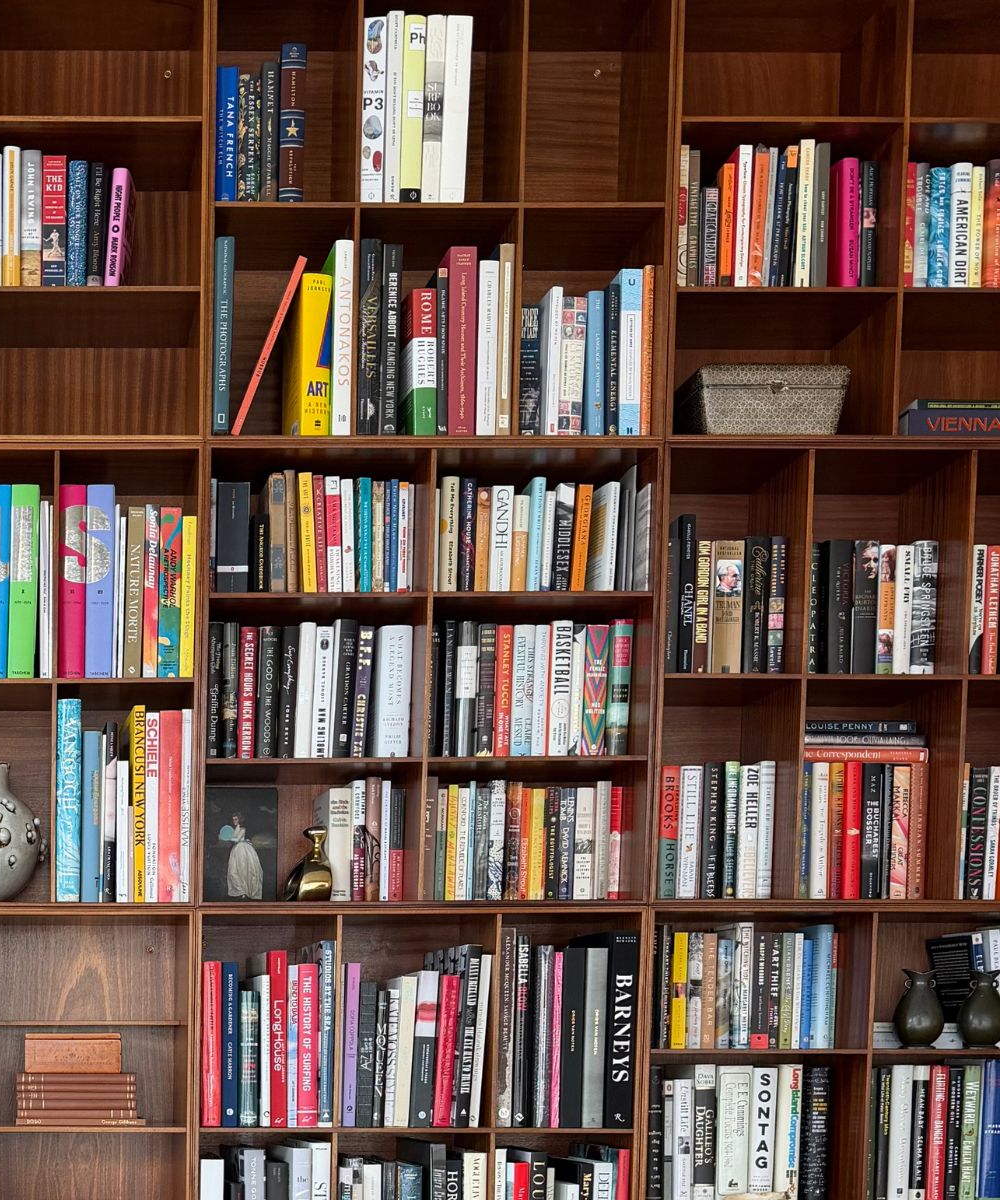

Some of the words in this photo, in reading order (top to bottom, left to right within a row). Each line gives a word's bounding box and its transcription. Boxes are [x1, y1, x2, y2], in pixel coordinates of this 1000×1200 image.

[226, 96, 235, 127] TANA
[363, 97, 383, 110] P3
[225, 133, 234, 178] FRENCH
[27, 162, 35, 187] JOHN
[46, 175, 63, 183] THE
[46, 184, 63, 192] KID
[27, 190, 35, 225] IRVING
[114, 185, 123, 202] NIGHT
[112, 202, 122, 223] PEOPLE
[955, 199, 969, 256] AMERICAN
[110, 237, 119, 254] MARK
[108, 255, 117, 278] RONSON
[954, 260, 967, 285] DIRT
[388, 272, 397, 309] BERENICE
[387, 310, 396, 338] ABBOTT
[420, 291, 432, 335] ROME
[338, 276, 351, 387] ANTONAKOS
[366, 296, 378, 379] VERSAILLES
[386, 341, 395, 379] CHANGING
[417, 340, 426, 386] HUGHES
[425, 340, 435, 385] ROBERT
[306, 381, 328, 398] ART
[386, 381, 394, 397] NEW
[385, 400, 394, 419] YORK
[926, 416, 1000, 432] VIENNA
[148, 509, 159, 539] Sonia
[495, 488, 510, 549] GANDHI
[169, 548, 178, 573] ANDY
[556, 519, 572, 572] MIDDLESEX
[698, 540, 711, 556] KIM
[920, 547, 932, 579] BRUCE
[128, 544, 141, 597] NATURE
[145, 540, 157, 590] Delaunay
[697, 556, 710, 588] GORDON
[975, 549, 985, 578] PARKER
[989, 551, 999, 594] JONATHAN
[162, 555, 170, 609] RETROSPECTIVE
[168, 574, 178, 609] WARHOL
[696, 590, 709, 606] GIRL
[975, 579, 984, 605] POSEY
[127, 600, 140, 644] MORTE
[683, 583, 694, 626] CHANEL
[696, 607, 708, 615] IN
[920, 582, 931, 646] SPRINGSTEEN
[988, 597, 998, 629] LETHEM
[358, 631, 373, 670] B.F.F.
[695, 623, 708, 644] BAND
[244, 643, 255, 671] SECRET
[502, 634, 511, 676] STANLEY
[554, 626, 572, 696] BASKETBALL
[243, 672, 254, 698] HOURS
[501, 679, 510, 708] TUCCI
[242, 700, 254, 719] MICK
[354, 694, 367, 737] CHRISTIE
[806, 721, 839, 731] LOUISE
[842, 721, 873, 730] PENNY
[63, 720, 77, 752] VAN
[134, 711, 144, 777] BRANCUSI
[146, 718, 158, 778] SCHIELE
[241, 722, 253, 751] HERRON
[63, 753, 77, 810] GOGH
[134, 782, 144, 809] NEW
[747, 768, 760, 789] ZOE
[663, 776, 675, 830] BROOKS
[745, 792, 758, 829] HELLER
[134, 812, 145, 847] YORK
[968, 787, 988, 886] CONFESSIONS
[663, 843, 675, 885] HORSE
[518, 944, 529, 985] ISABELLA
[302, 976, 312, 993] THE
[302, 997, 312, 1035] HISTORY
[612, 974, 633, 1083] BARNEYS
[271, 1000, 284, 1072] LongHouse
[302, 1038, 311, 1049] OF
[301, 1053, 311, 1092] SURFING
[963, 1081, 980, 1124] WEYWARD
[694, 1106, 706, 1168] DAUGHTER
[704, 1109, 714, 1164] GALILEO'S
[755, 1073, 772, 1169] SONTAG
